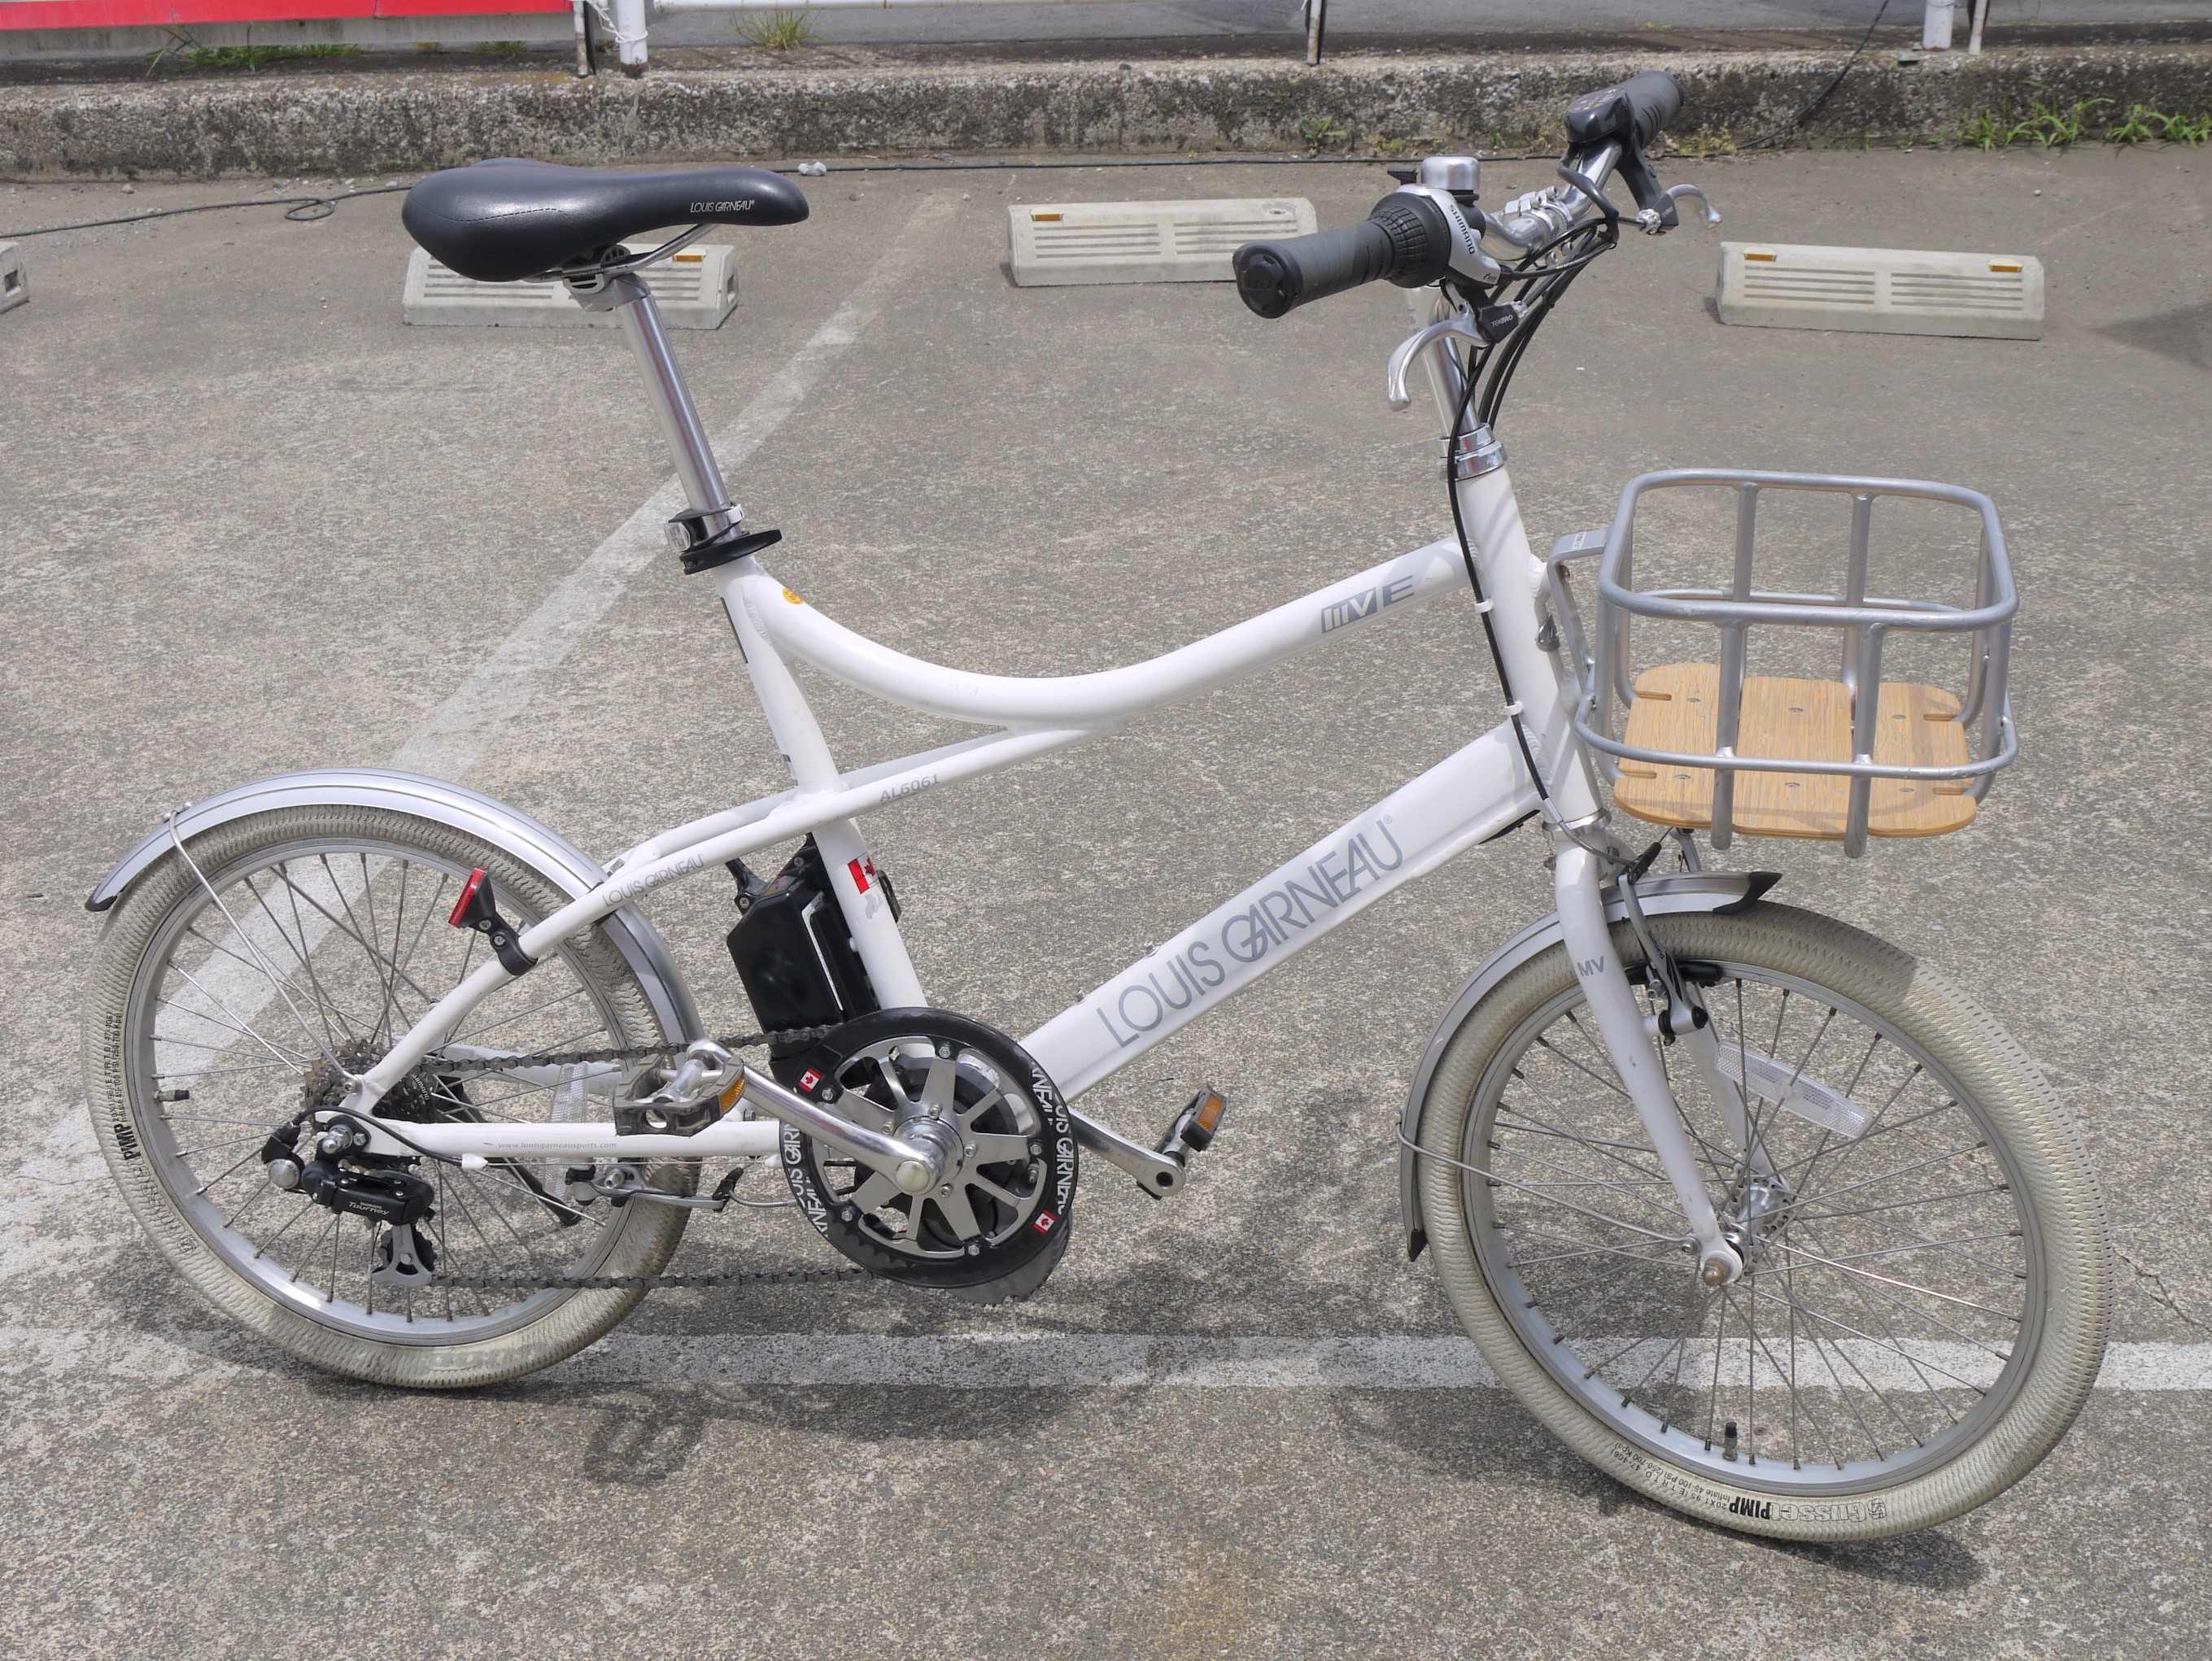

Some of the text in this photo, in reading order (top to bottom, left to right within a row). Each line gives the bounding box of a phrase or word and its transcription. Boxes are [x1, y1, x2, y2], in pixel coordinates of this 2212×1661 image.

[690, 202, 714, 212] LOUIS
[1449, 204, 1476, 255] SHIMANO
[879, 774, 940, 802] AL6061
[603, 880, 644, 907] LOUIS
[1577, 956, 1604, 977] MV
[1096, 940, 1225, 1048] LOUIS
[499, 1141, 617, 1149] www.louisgarneausports.com
[349, 1201, 390, 1215] Tourney
[1664, 1471, 1678, 1483] PSI
[1678, 1479, 1704, 1494] 45-100
[1706, 1489, 1730, 1503] Inflate
[1729, 1496, 1867, 1523] Gusset PIMP
